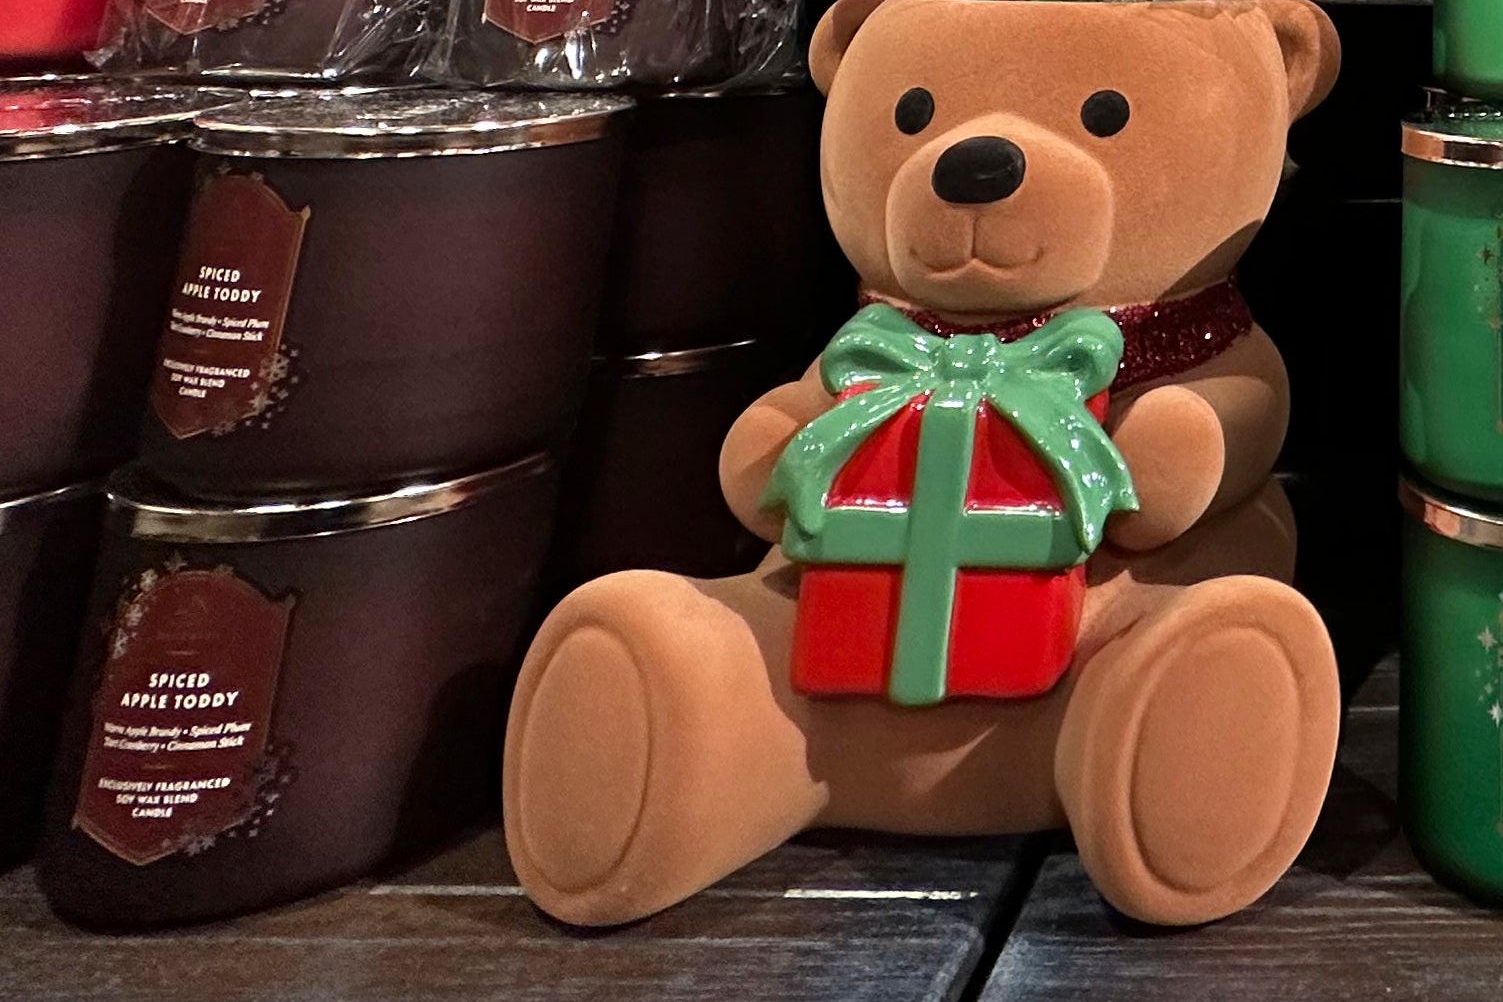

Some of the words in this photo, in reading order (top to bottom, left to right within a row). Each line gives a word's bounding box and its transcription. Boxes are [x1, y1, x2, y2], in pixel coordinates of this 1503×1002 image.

[199, 266, 240, 282] SPICED
[181, 283, 210, 299] APPLE
[214, 287, 262, 303] TODDY
[149, 673, 210, 688] SPICED
[121, 693, 167, 708] APPLE
[174, 691, 238, 709] TODDY
[156, 778, 230, 792] FRAGRANCED
[163, 794, 198, 804] BLEND
[132, 808, 172, 818] CANDLE
